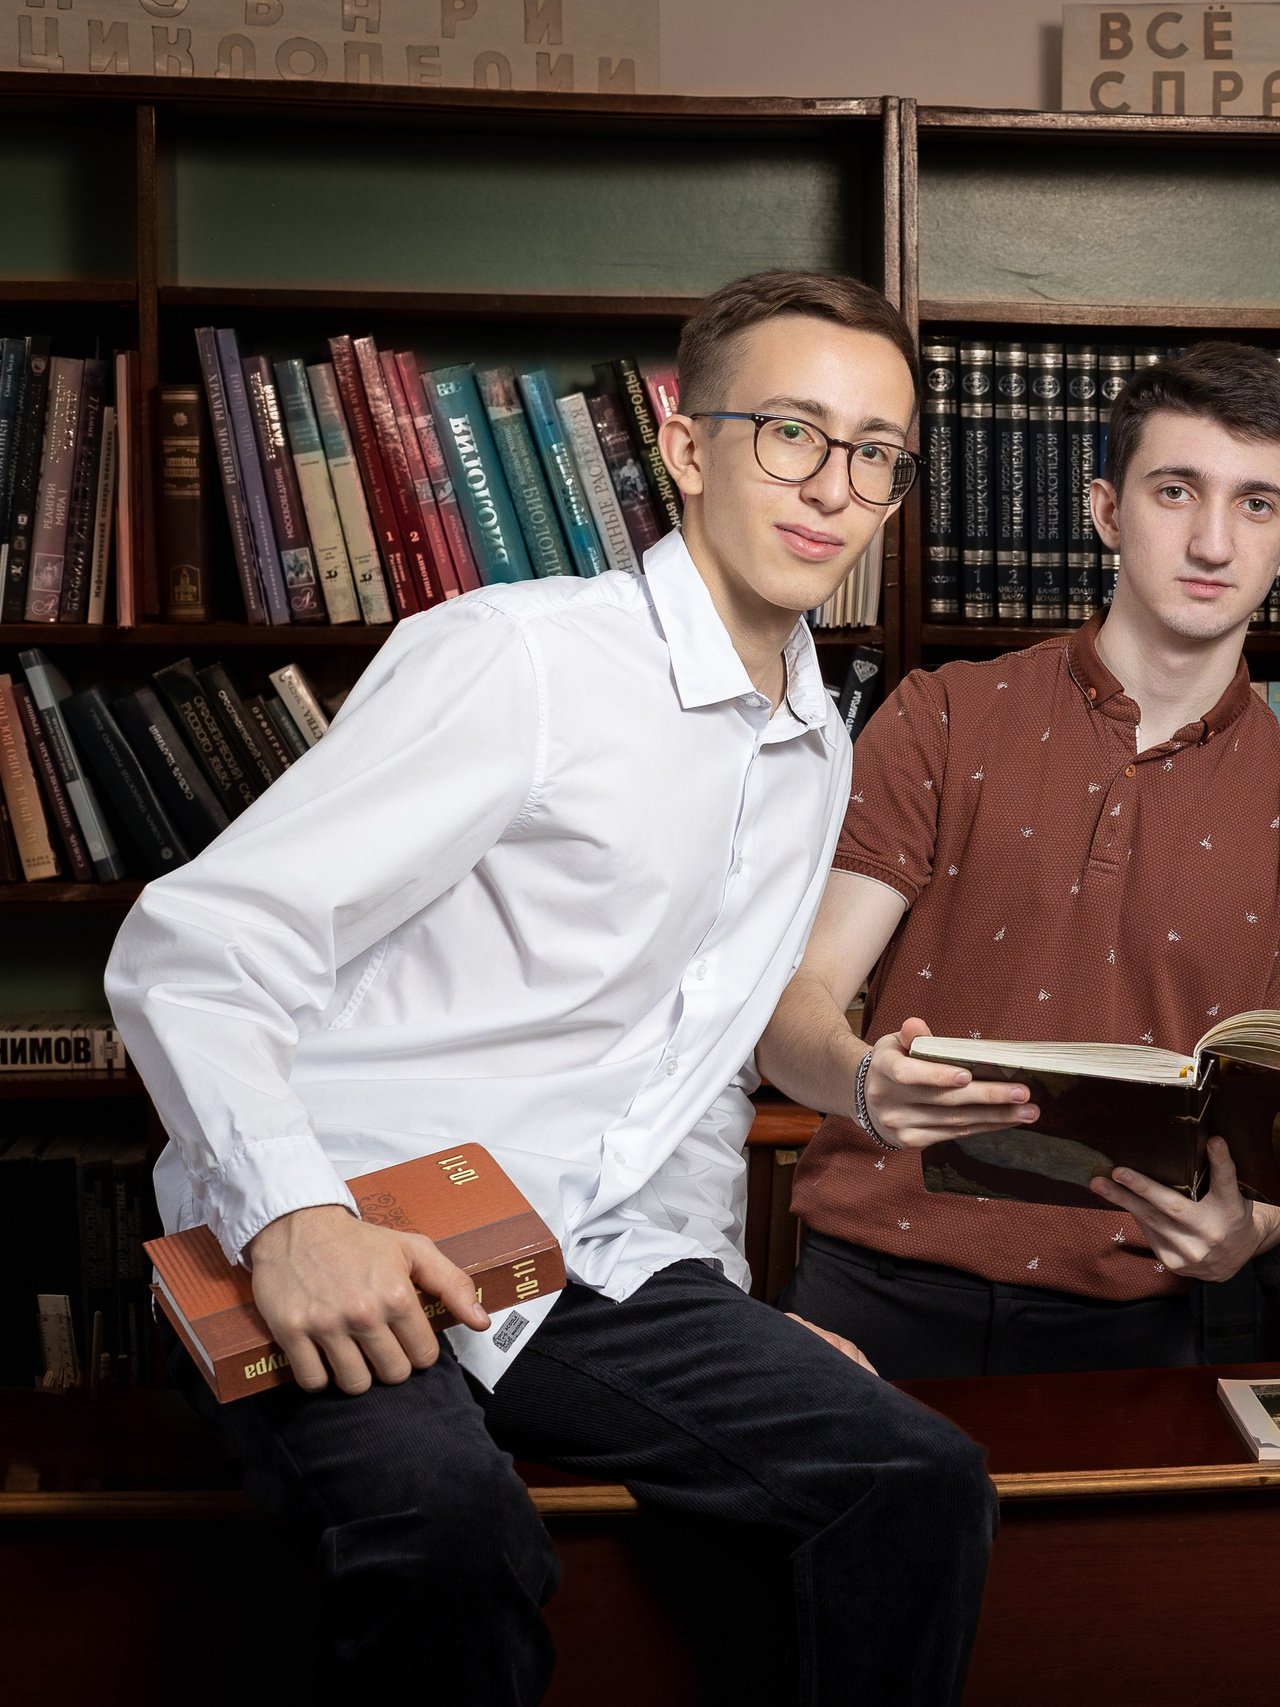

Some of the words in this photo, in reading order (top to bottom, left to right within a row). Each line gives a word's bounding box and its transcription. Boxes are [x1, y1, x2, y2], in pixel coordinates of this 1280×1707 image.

[1099, 5, 1232, 61] ВСЁ
[87, 395, 99, 409] 77
[207, 373, 226, 422] ХРАМЫ
[621, 369, 658, 445] ПРИРОДЫ
[103, 430, 114, 480] школьника
[216, 426, 237, 485] МОСКВЫ
[645, 445, 675, 501] ЖИЗНЬ
[1072, 434, 1080, 493] РОССИЙСКАЯ
[101, 483, 111, 518] словарь
[444, 412, 513, 568] БИОЛОГИЯ
[940, 426, 951, 534] ЭНЦИКЛОПЕДИЯ
[977, 430, 988, 537] ЭНЦИКЛОПЕДИЯ
[1012, 432, 1022, 538] ЭНЦИКЛОПЕДИЯ
[1048, 433, 1059, 540] ЭНЦИКЛОПЕДИЯ
[42, 482, 57, 529] РЕЛИГИИ
[54, 495, 67, 525] МИРА
[274, 468, 295, 539] МОСКВОВЕДЕНИЕ
[966, 493, 974, 537] БОЛЬШАЯ
[1002, 494, 1010, 538] БОЛЬШАЯ
[1072, 496, 1080, 540] БОЛЬШАЯ
[384, 531, 394, 541] 1
[409, 530, 420, 542] 2
[94, 522, 107, 597] Мифологический
[413, 551, 435, 599] ЖИВОТНЫЕ
[974, 569, 980, 584] 1
[1008, 569, 1018, 584] 2
[1044, 571, 1053, 585] 3
[1078, 571, 1088, 586] 4
[22, 694, 42, 736] ТЕРМИНОВ
[186, 694, 248, 779] ОРФОЭПИЧЕСКИЙ
[147, 724, 177, 767] УДАРЕНИЙ
[176, 700, 216, 753] РУССКОГО
[206, 754, 234, 790] ЯЗЫКА
[170, 765, 195, 801] СЛОВАРЬ
[68, 832, 85, 867] СЛОВАРЬ
[439, 1154, 479, 1186] 10-11
[512, 1259, 539, 1300] 10-11
